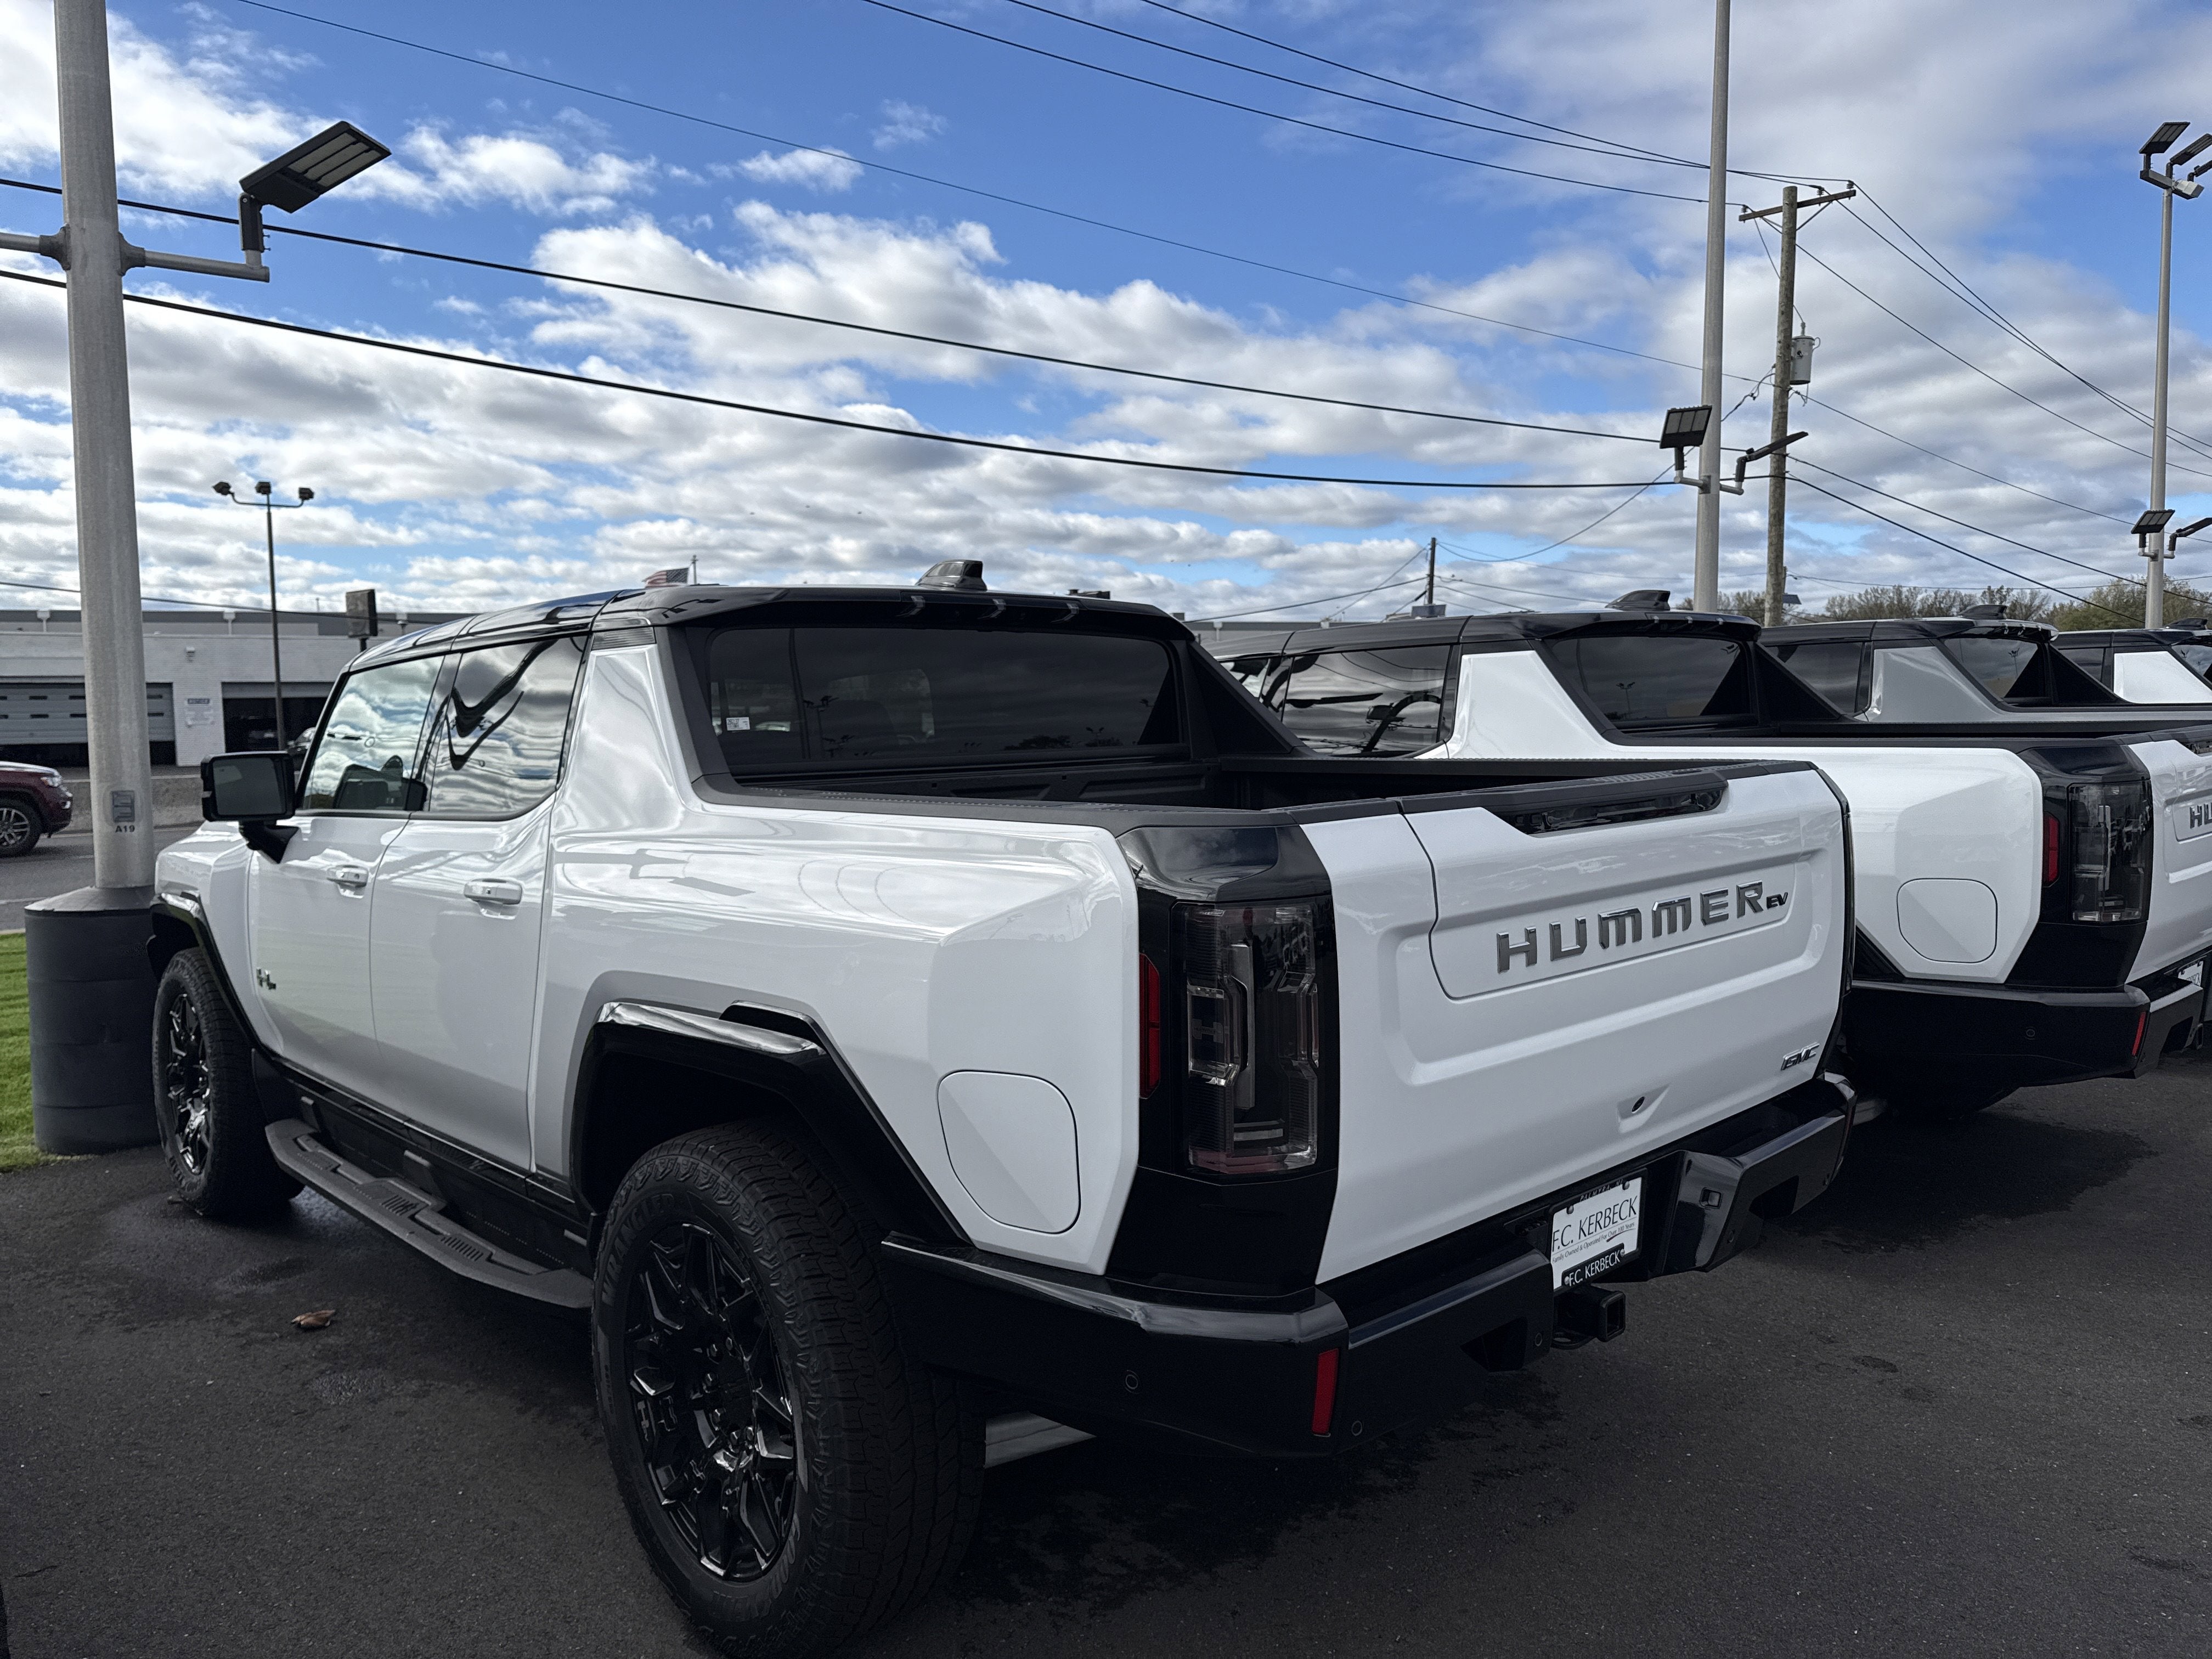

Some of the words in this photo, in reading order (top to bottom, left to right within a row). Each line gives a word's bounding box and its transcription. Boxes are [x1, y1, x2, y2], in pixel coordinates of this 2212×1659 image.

[115, 825, 136, 833] A19
[1497, 879, 1764, 973] HUMMER
[1766, 892, 1788, 910] EV
[1780, 1042, 1820, 1071] GMC
[1552, 1224, 1573, 1252] F.C.
[1579, 1195, 1638, 1240] KERBECK
[1552, 1254, 1564, 1263] Family
[1565, 1244, 1579, 1258] Owned
[1583, 1237, 1601, 1249] Operated
[1608, 1229, 1617, 1238] Over
[1569, 1269, 1583, 1286] F.C.
[1585, 1250, 1620, 1279] KERBECK
